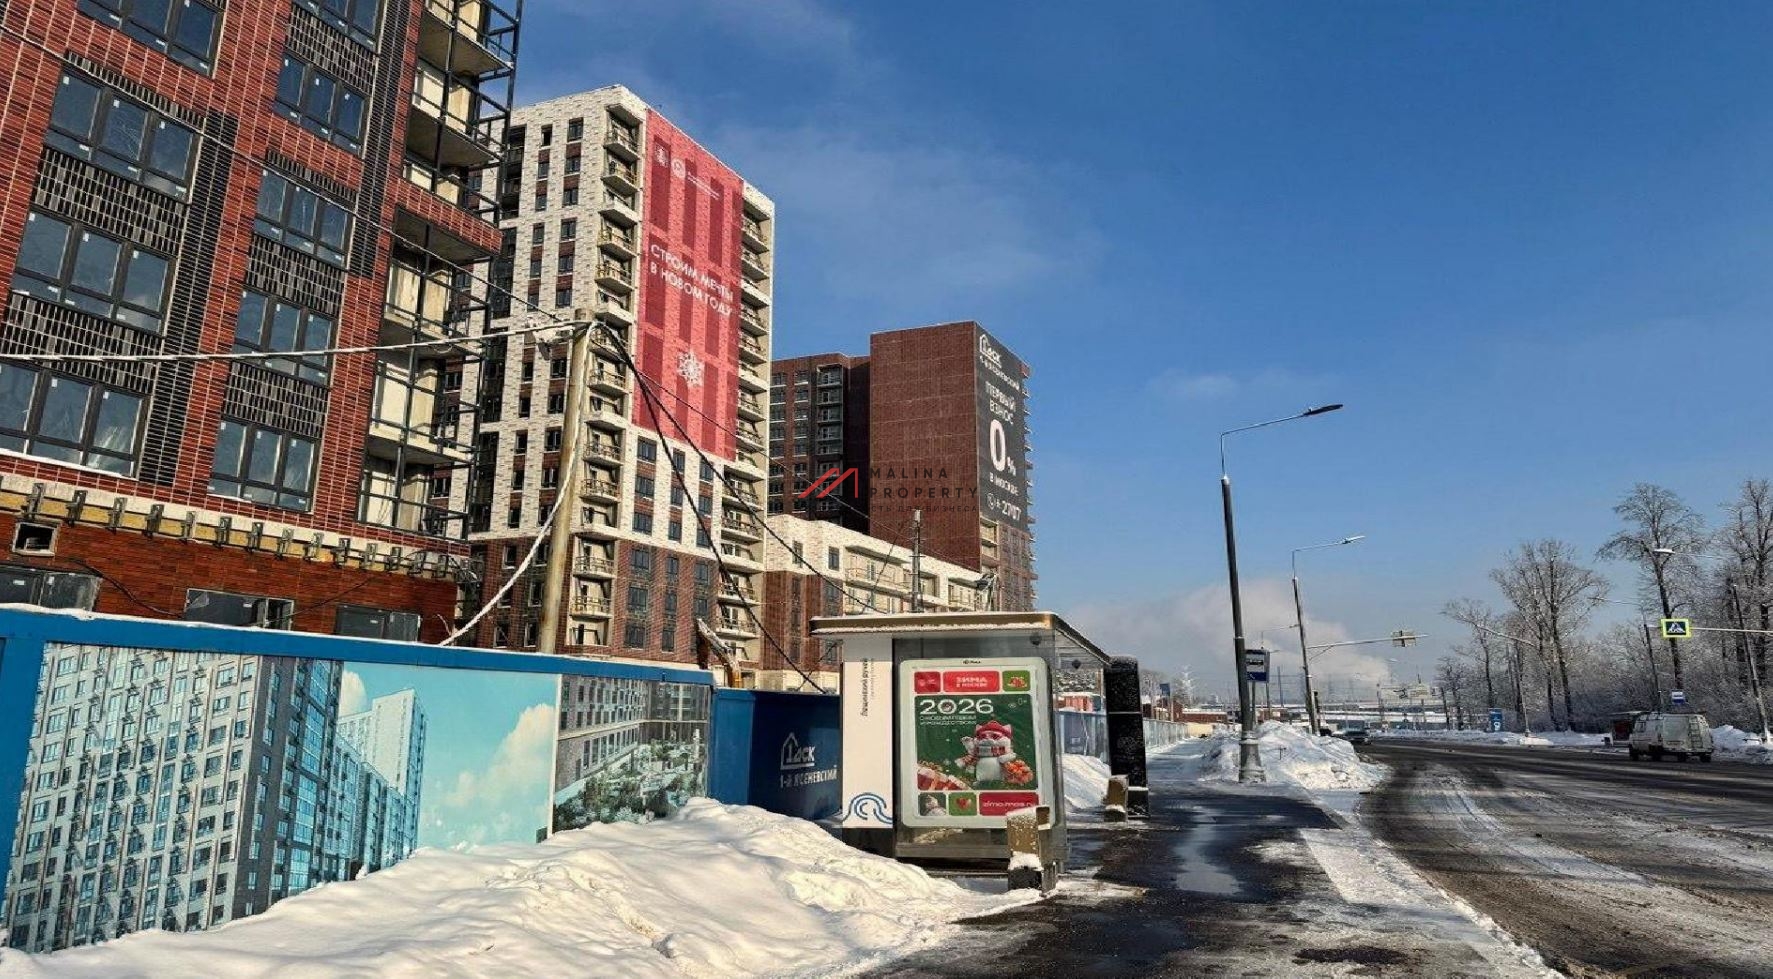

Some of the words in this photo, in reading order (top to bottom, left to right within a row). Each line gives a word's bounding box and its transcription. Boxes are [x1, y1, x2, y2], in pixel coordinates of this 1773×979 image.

[650, 262, 657, 275] В
[662, 268, 703, 299] НОВОМ
[705, 293, 732, 316] ГОДУ
[651, 244, 697, 279] СТРОИМ
[701, 274, 733, 303] МЕЧТЫ
[986, 381, 1016, 412] ПЕРВЫЙ
[990, 399, 1014, 425] ВЗНОС
[920, 699, 994, 715] 2026
